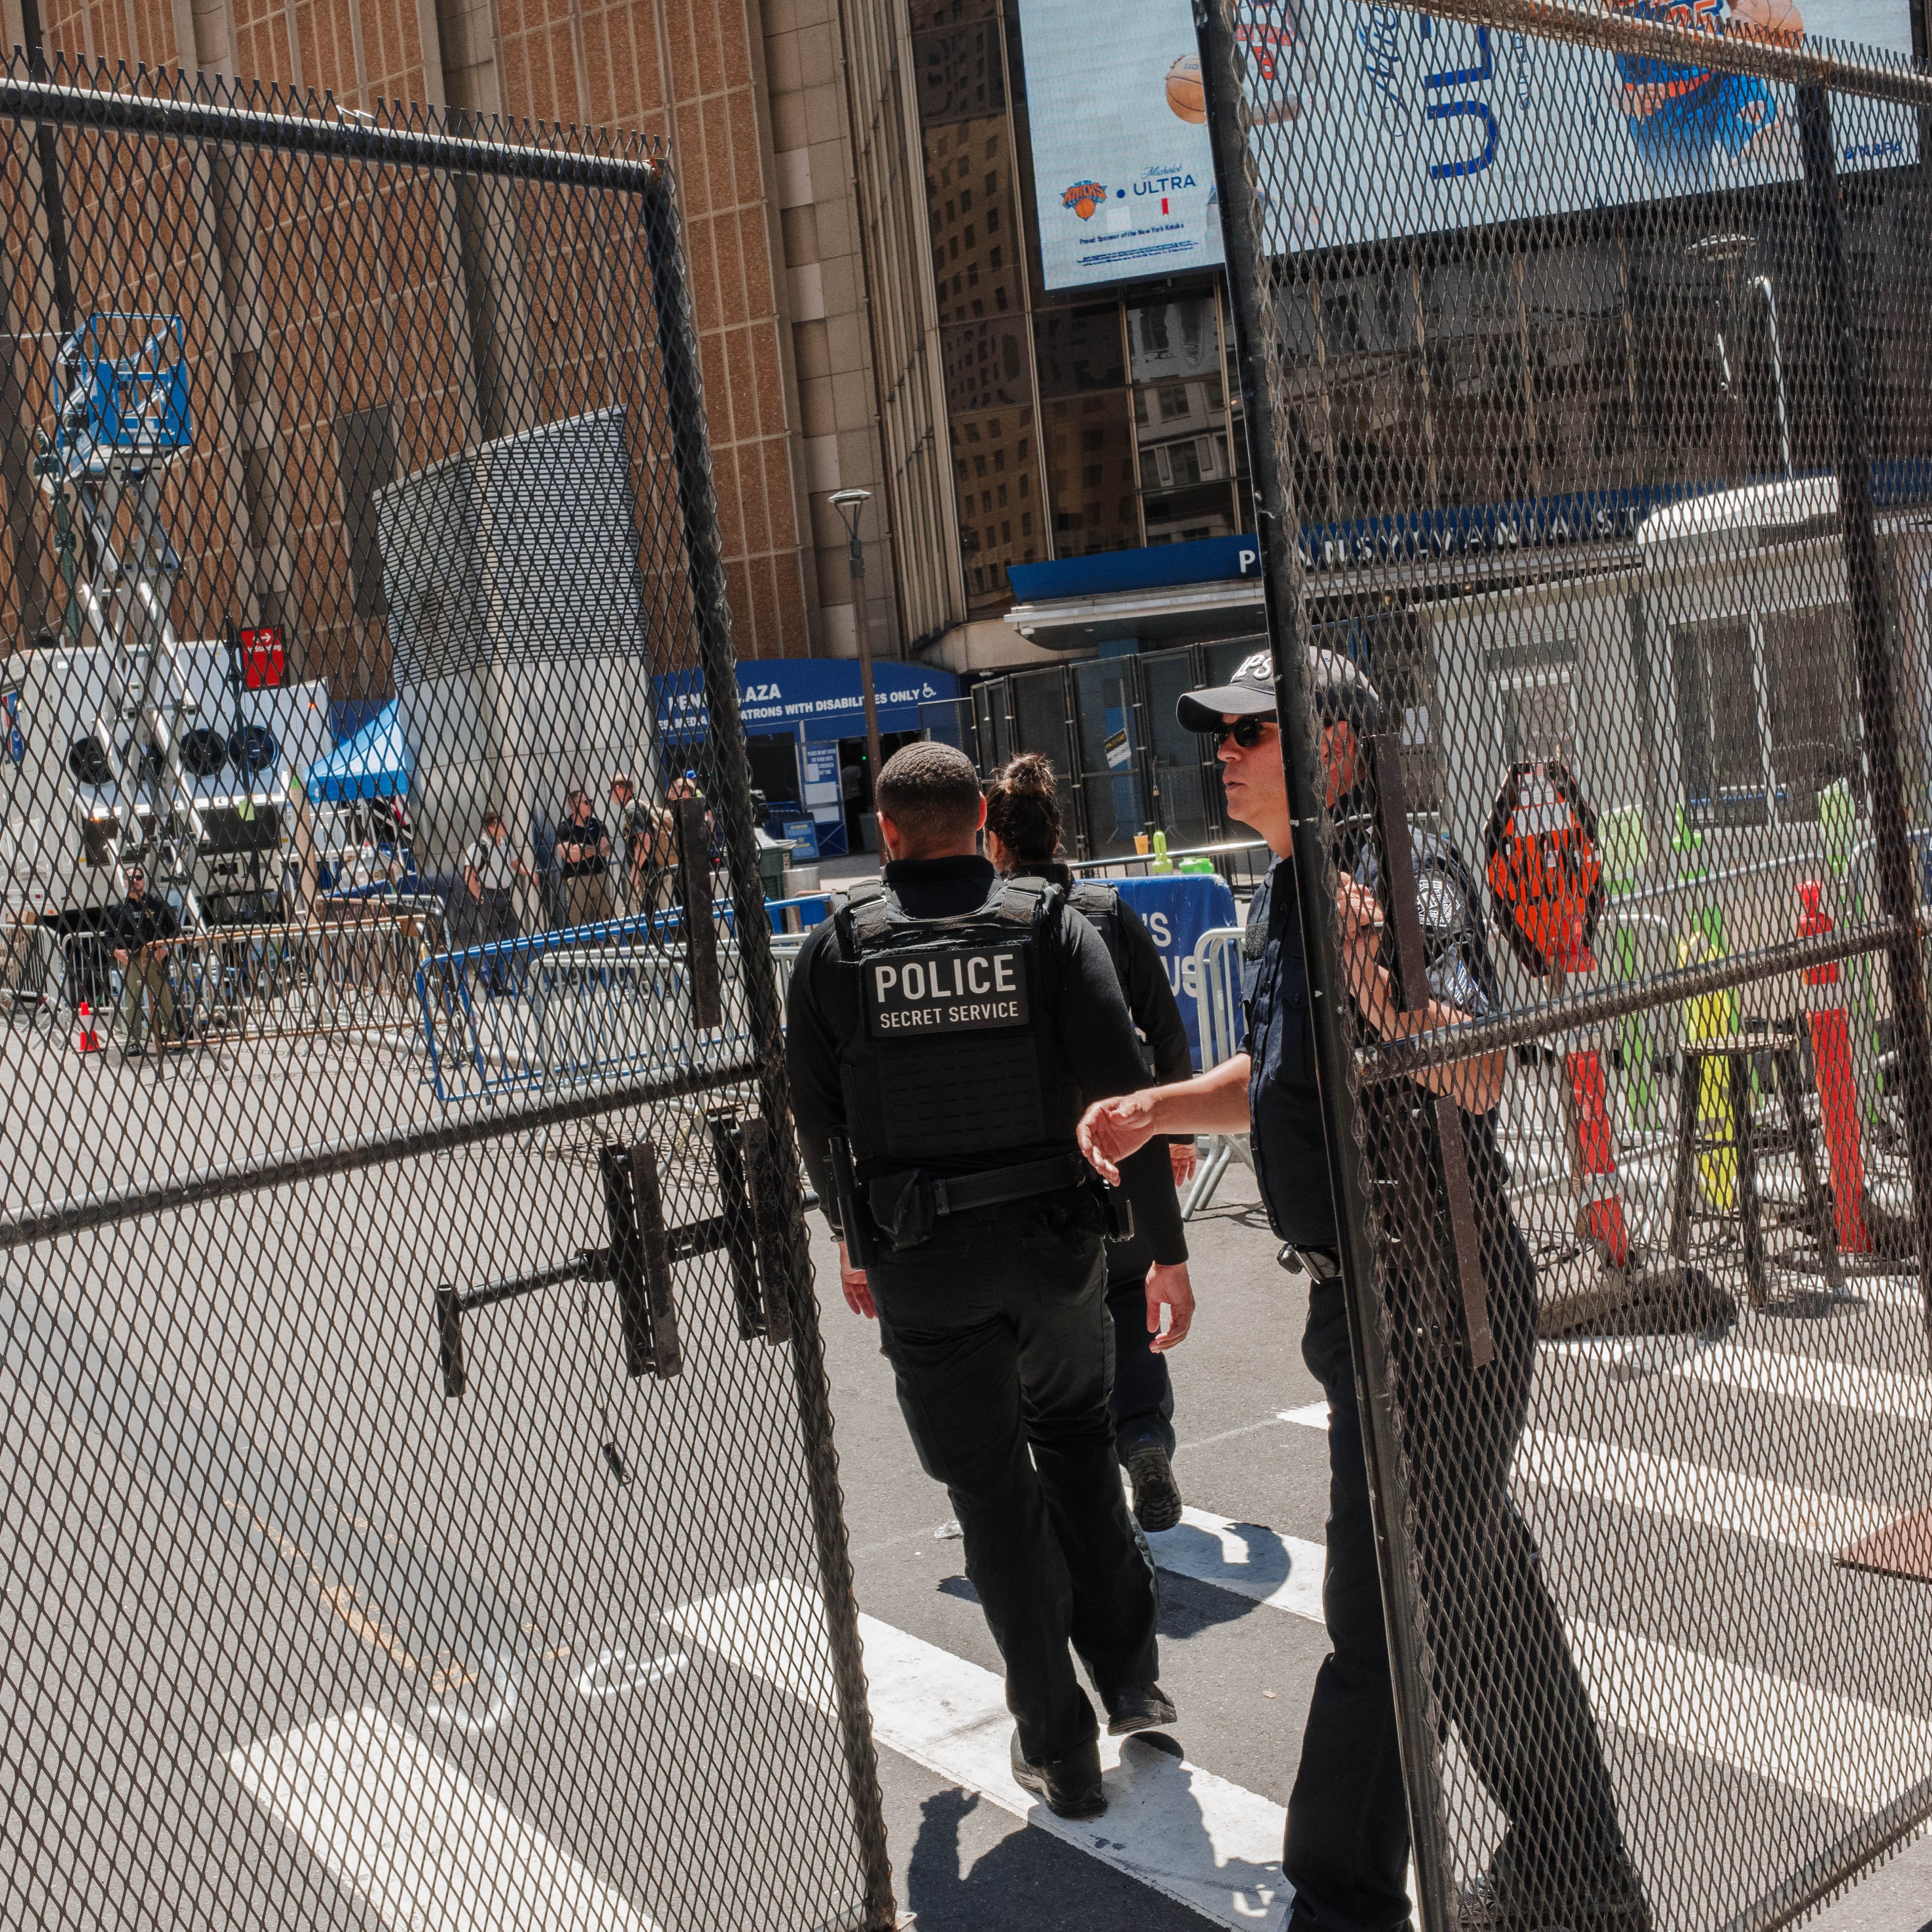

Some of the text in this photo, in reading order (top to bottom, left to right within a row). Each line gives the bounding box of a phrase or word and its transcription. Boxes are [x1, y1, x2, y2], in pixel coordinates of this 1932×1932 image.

[1133, 174, 1196, 196] ULTRA
[1239, 503, 1661, 573] PNSYLVANIA ST
[736, 684, 781, 703] LAZA
[741, 706, 783, 720] ATRONS
[785, 701, 813, 715] WITH
[816, 693, 887, 711] DISABILIES
[890, 689, 920, 702] ONLY
[875, 954, 1016, 1003] POLICE
[880, 1001, 1019, 1028] SECRET SERVICE
